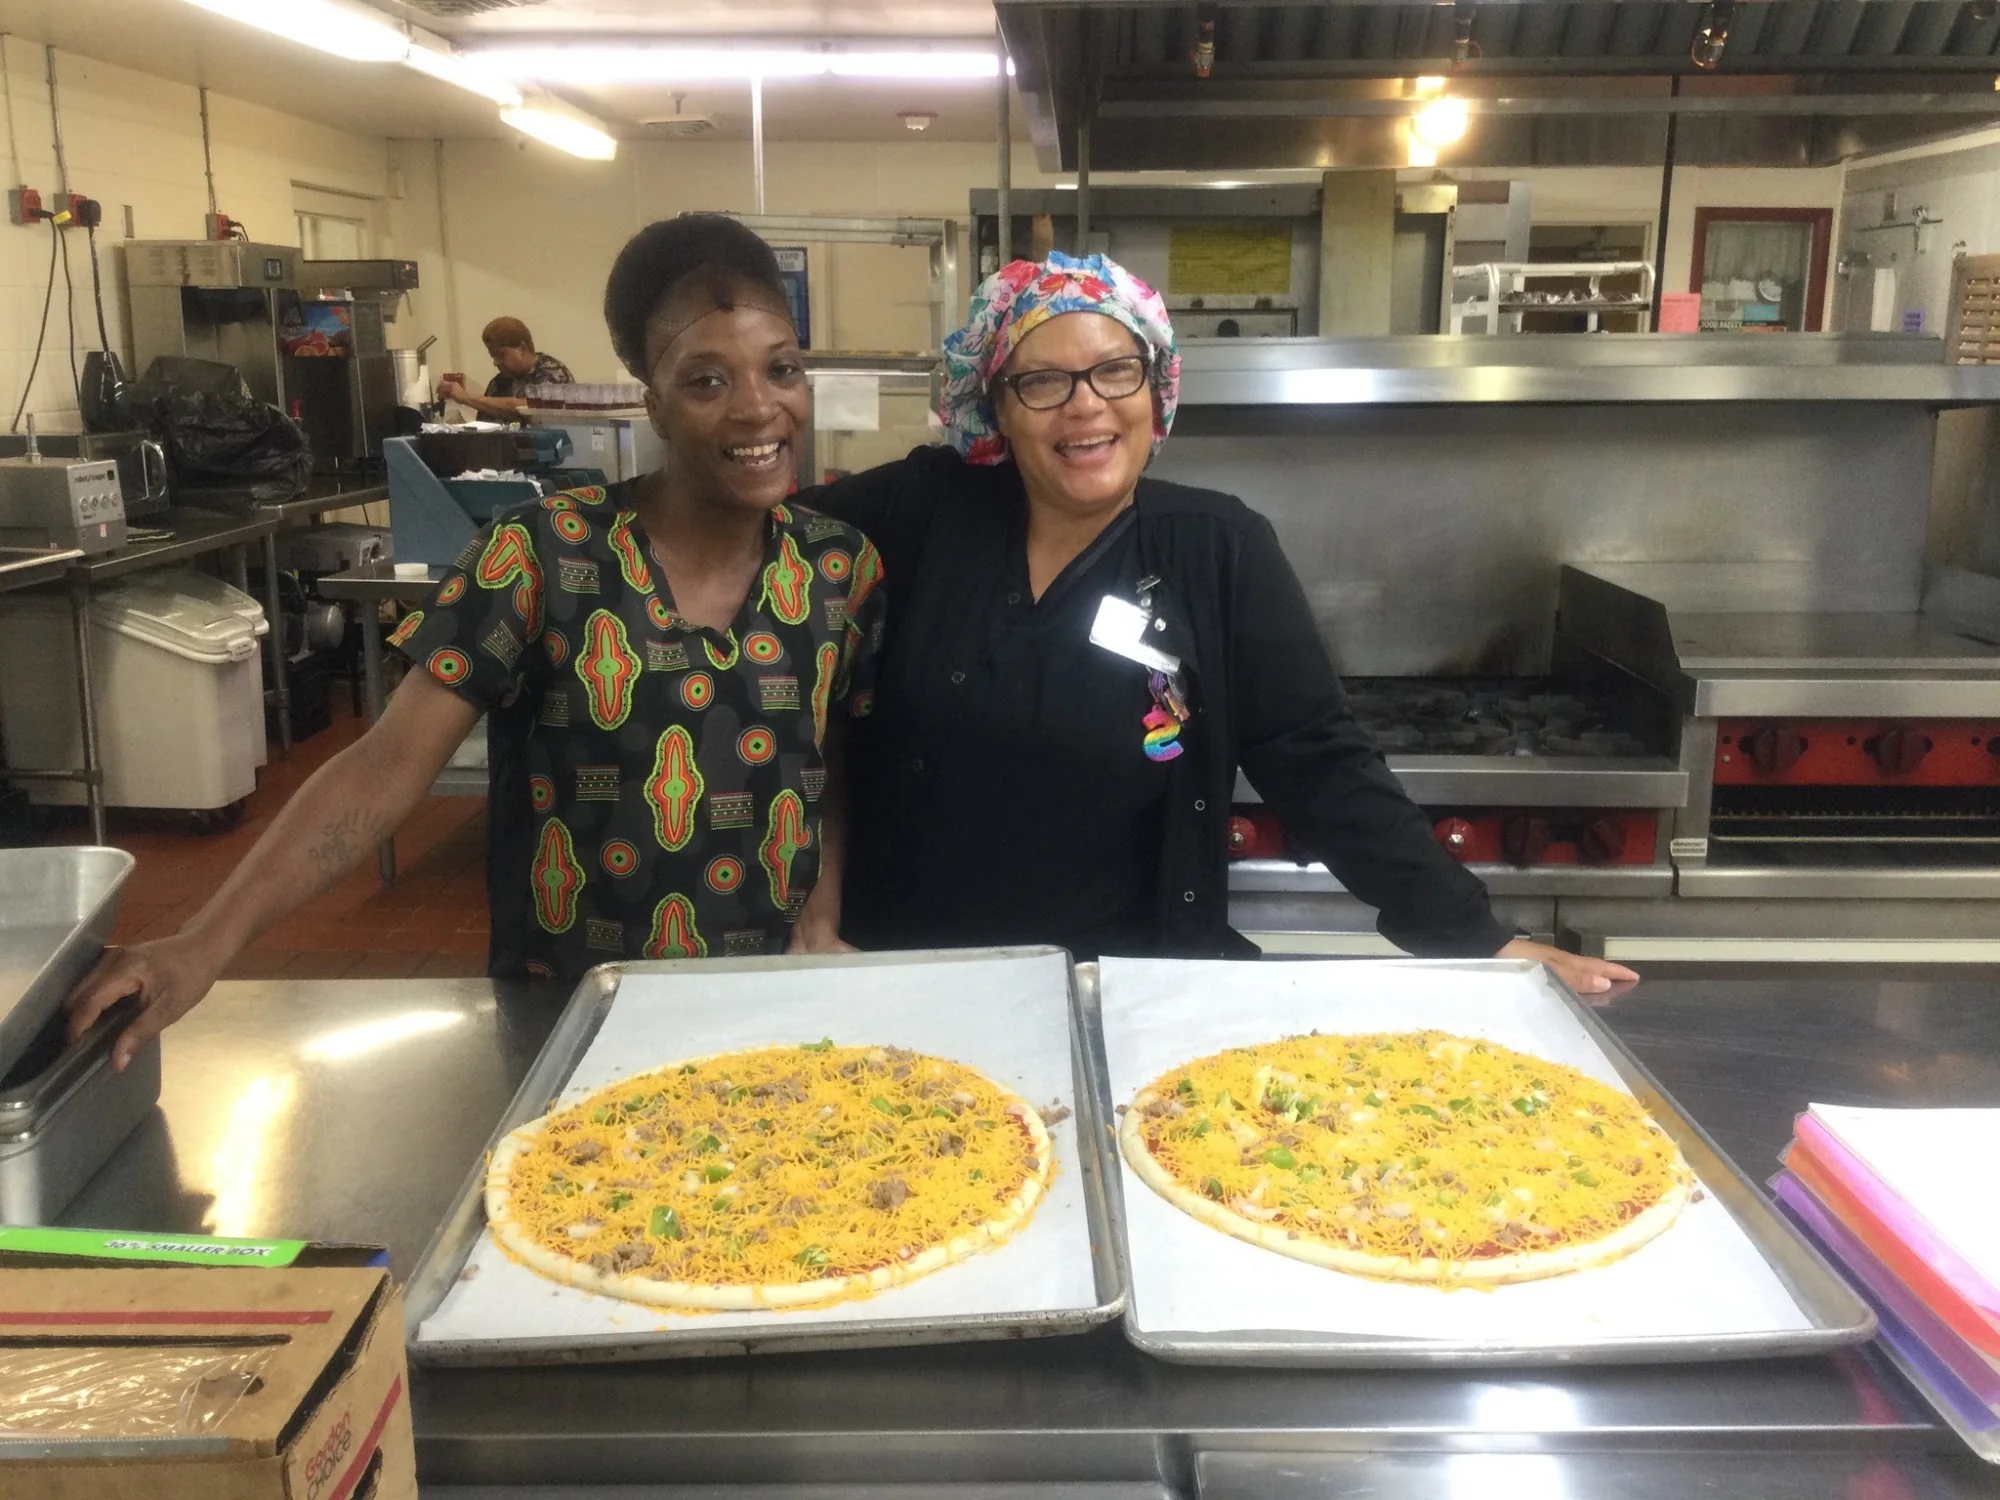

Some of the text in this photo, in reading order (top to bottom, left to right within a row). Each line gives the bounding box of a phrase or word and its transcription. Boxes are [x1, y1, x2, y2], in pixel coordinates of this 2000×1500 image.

[146, 1243, 225, 1255] SMALLER
[226, 1246, 270, 1257] BOX
[305, 1411, 351, 1482] Gordon
